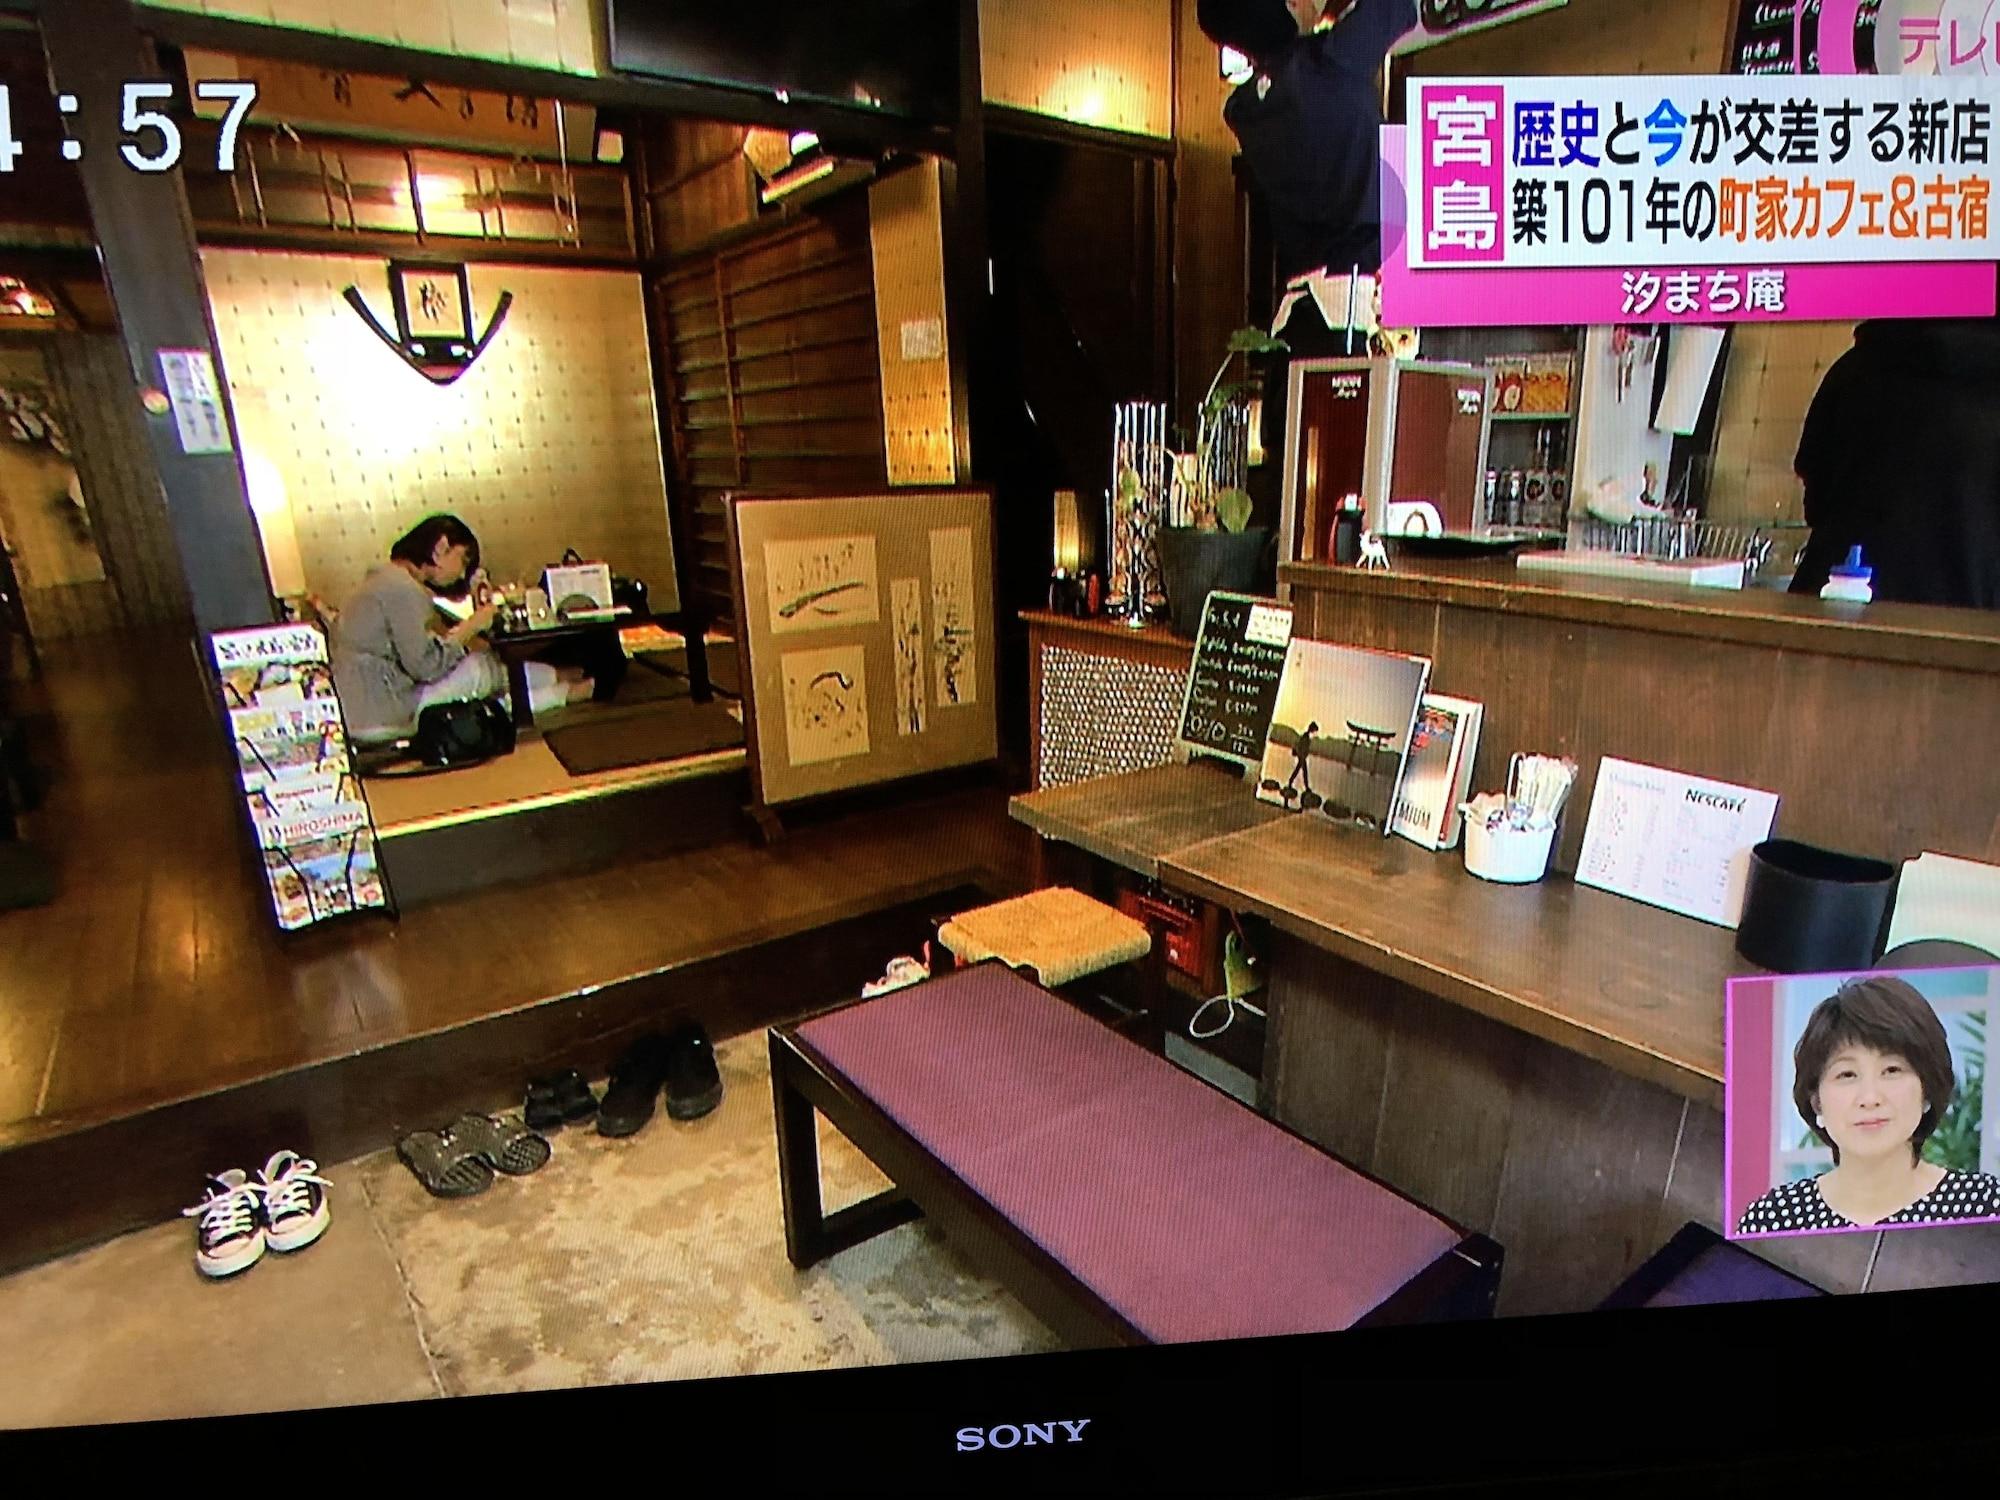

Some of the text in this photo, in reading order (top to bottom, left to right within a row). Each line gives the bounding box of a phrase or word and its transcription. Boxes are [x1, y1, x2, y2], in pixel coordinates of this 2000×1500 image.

[1899, 18, 2000, 66] テレ
[1512, 97, 1990, 168] 歴史と今が交差する新店
[1427, 95, 1498, 250] 宮島
[1512, 174, 1990, 246] 築101年の町家カフェ&古宿
[1621, 268, 1785, 314] 汐まち庵
[955, 1419, 1091, 1452] SONY
